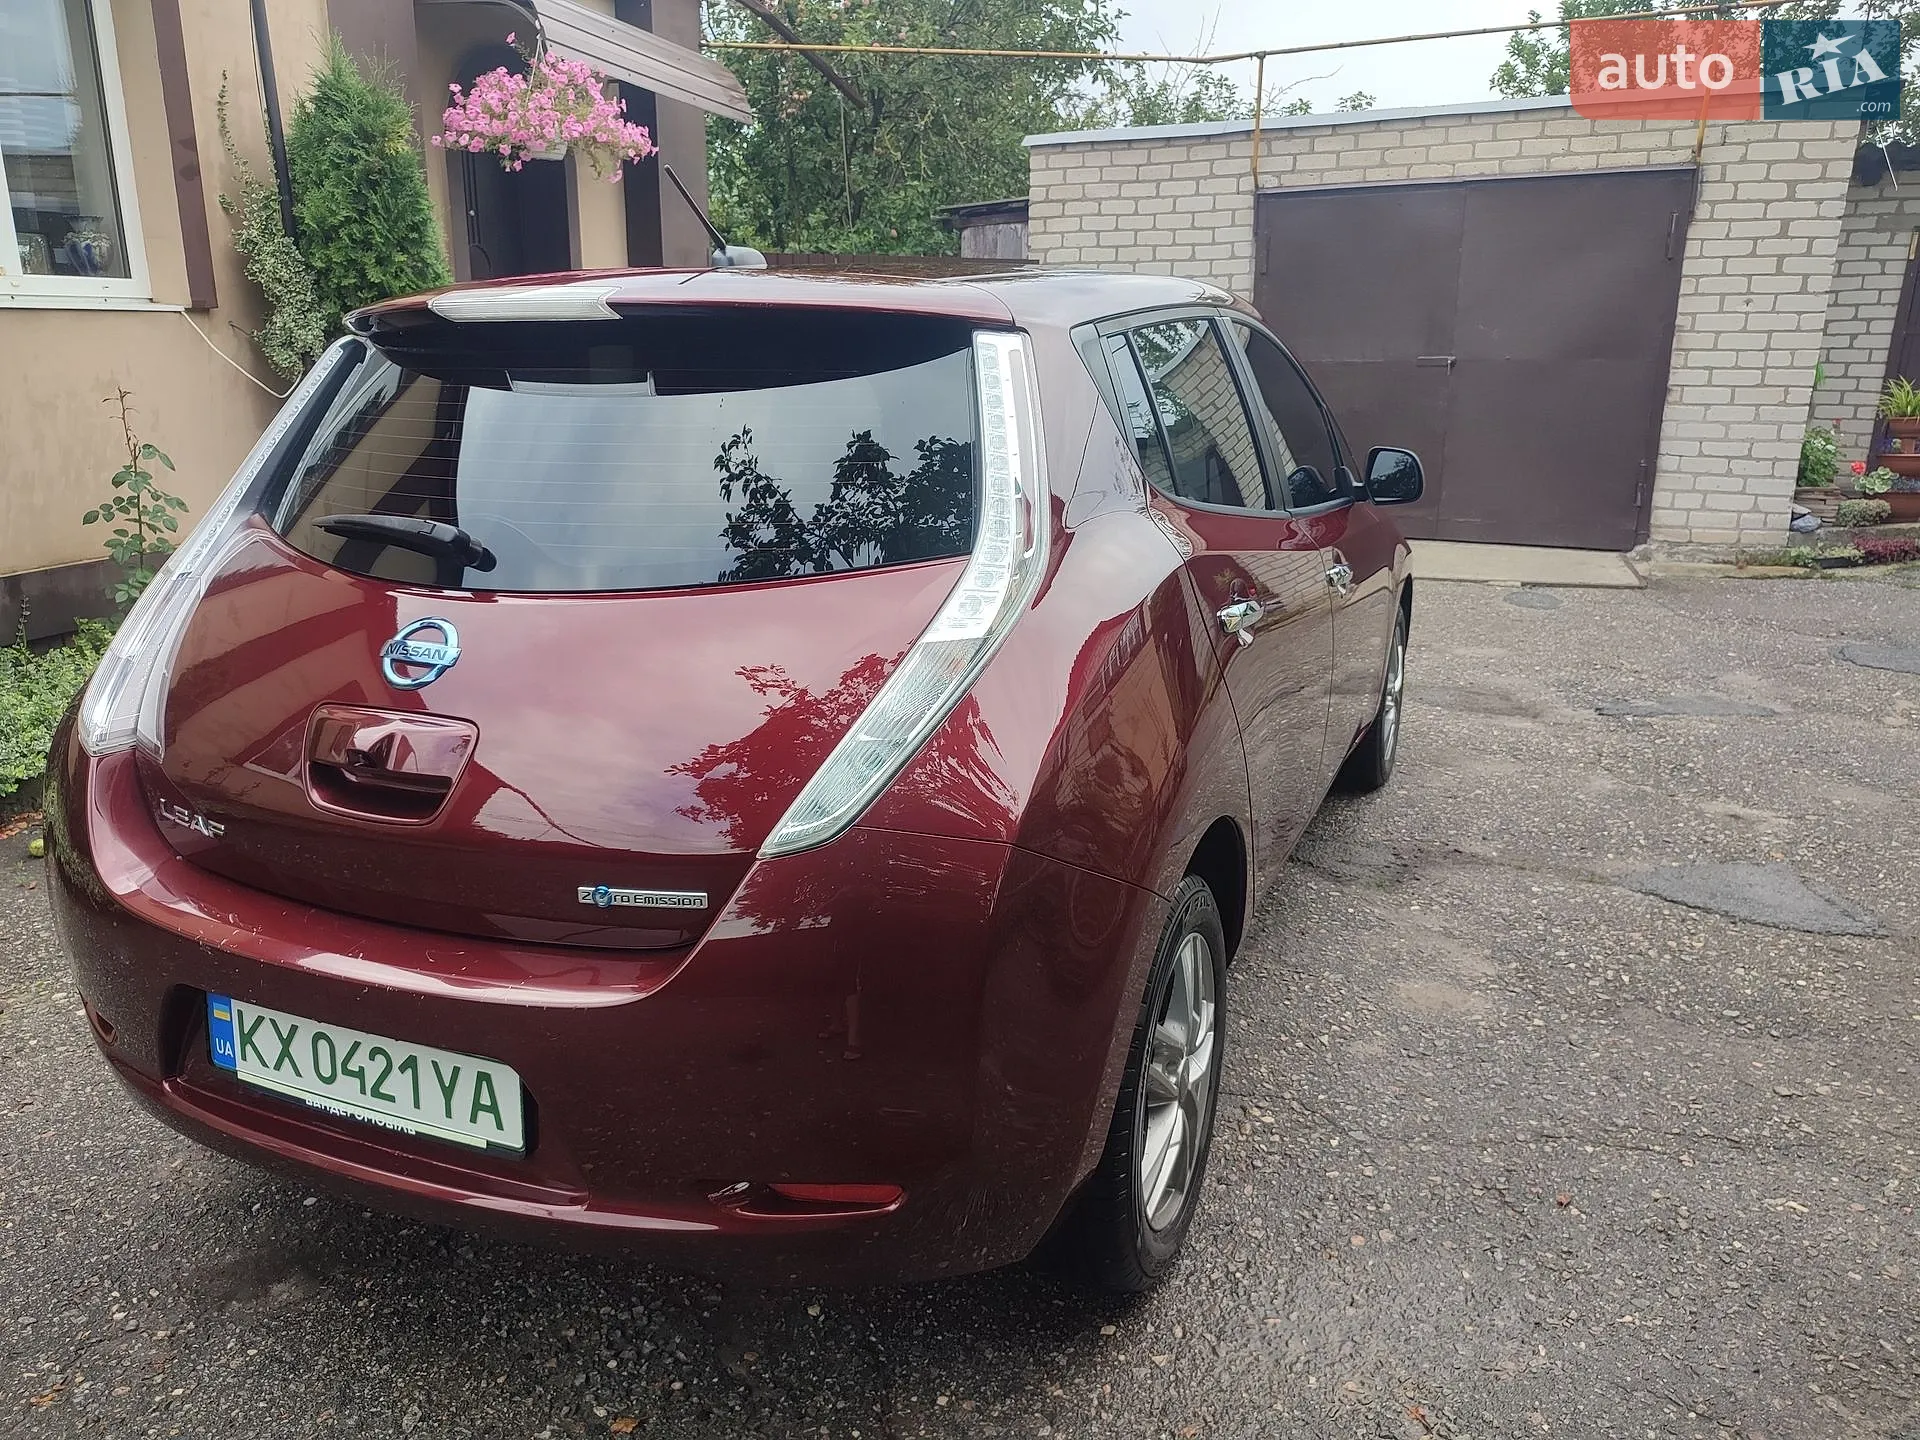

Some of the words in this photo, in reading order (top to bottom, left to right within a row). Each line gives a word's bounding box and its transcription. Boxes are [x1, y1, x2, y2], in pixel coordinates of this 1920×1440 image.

[384, 643, 449, 661] NISSAN
[159, 798, 225, 838] LEAF
[215, 1037, 234, 1058] UA
